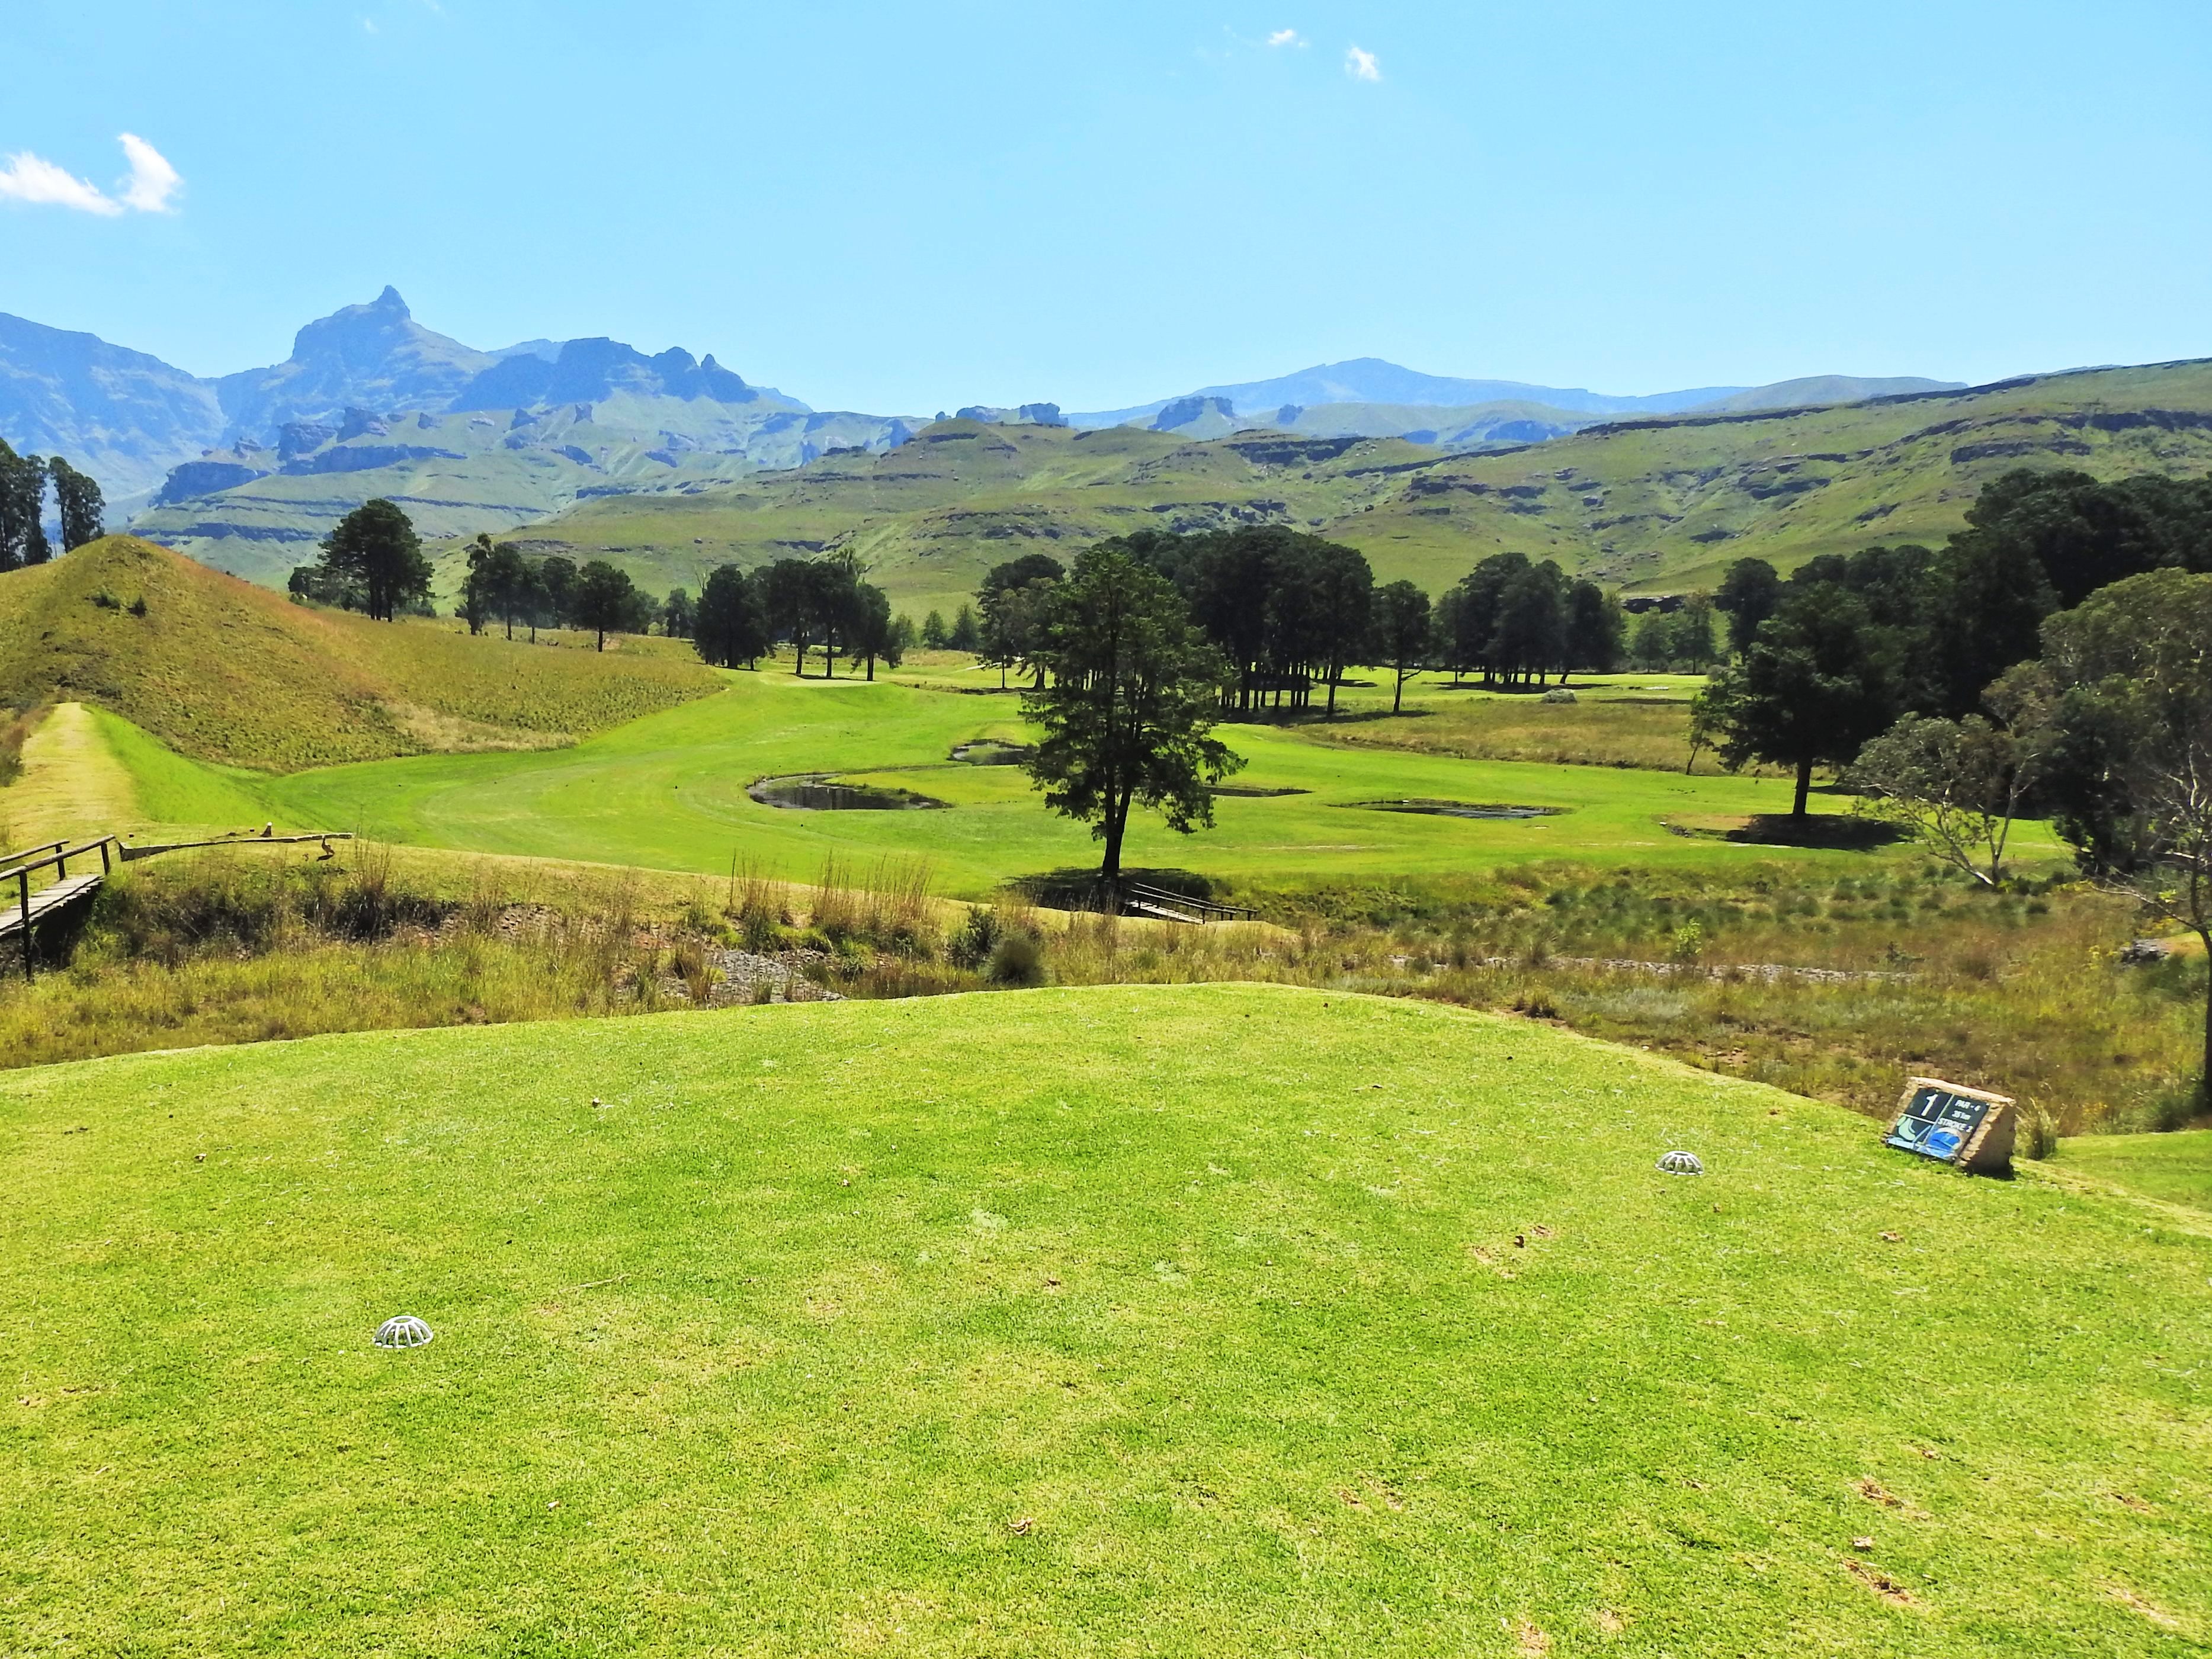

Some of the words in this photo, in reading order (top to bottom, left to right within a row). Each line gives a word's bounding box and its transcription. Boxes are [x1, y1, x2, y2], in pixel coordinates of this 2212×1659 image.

[1921, 1093, 1938, 1116] 1
[1954, 1099, 1970, 1109] PAR
[1937, 1118, 1967, 1131] STROKE
